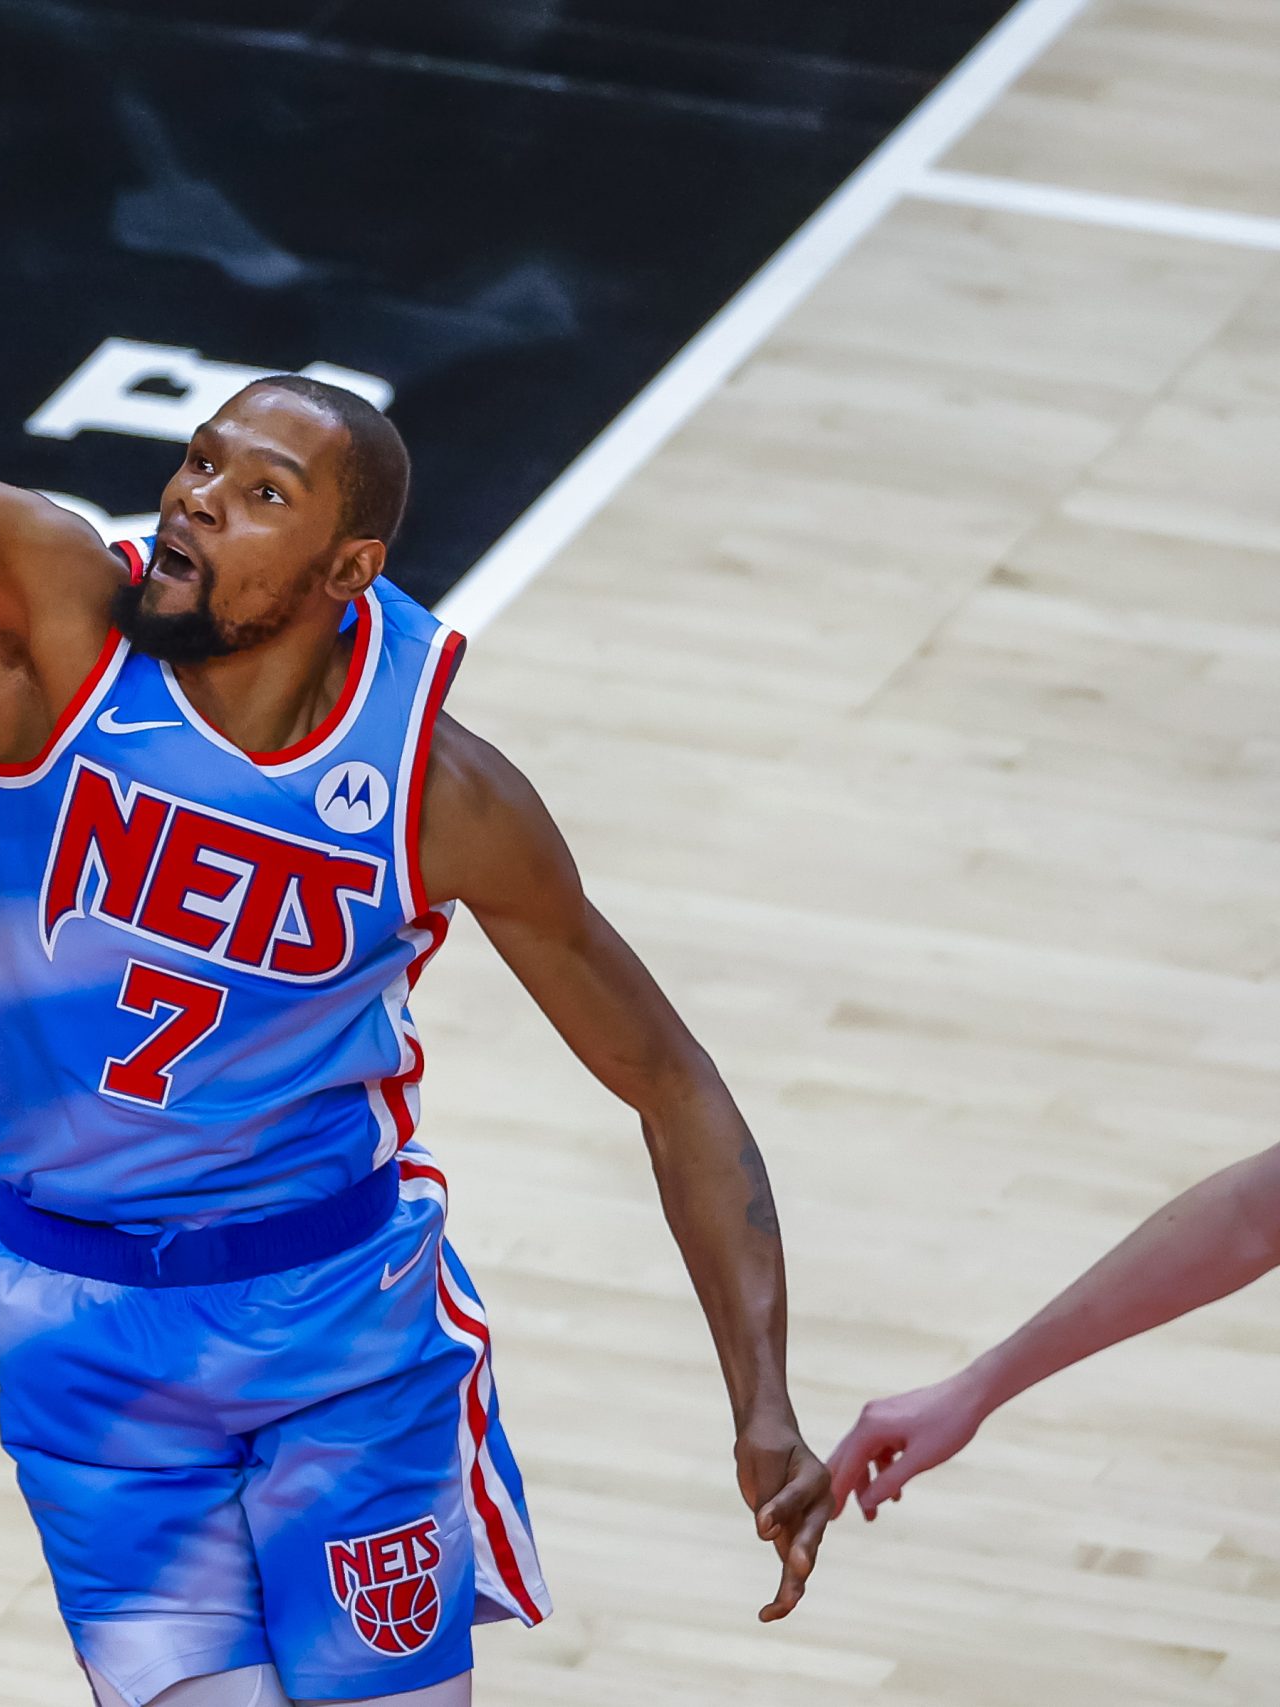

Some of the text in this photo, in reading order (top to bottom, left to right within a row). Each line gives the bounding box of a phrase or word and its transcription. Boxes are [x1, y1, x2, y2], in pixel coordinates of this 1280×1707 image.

[39, 754, 387, 984] NETS
[99, 958, 229, 1110] 7
[324, 1514, 441, 1612] NETS
